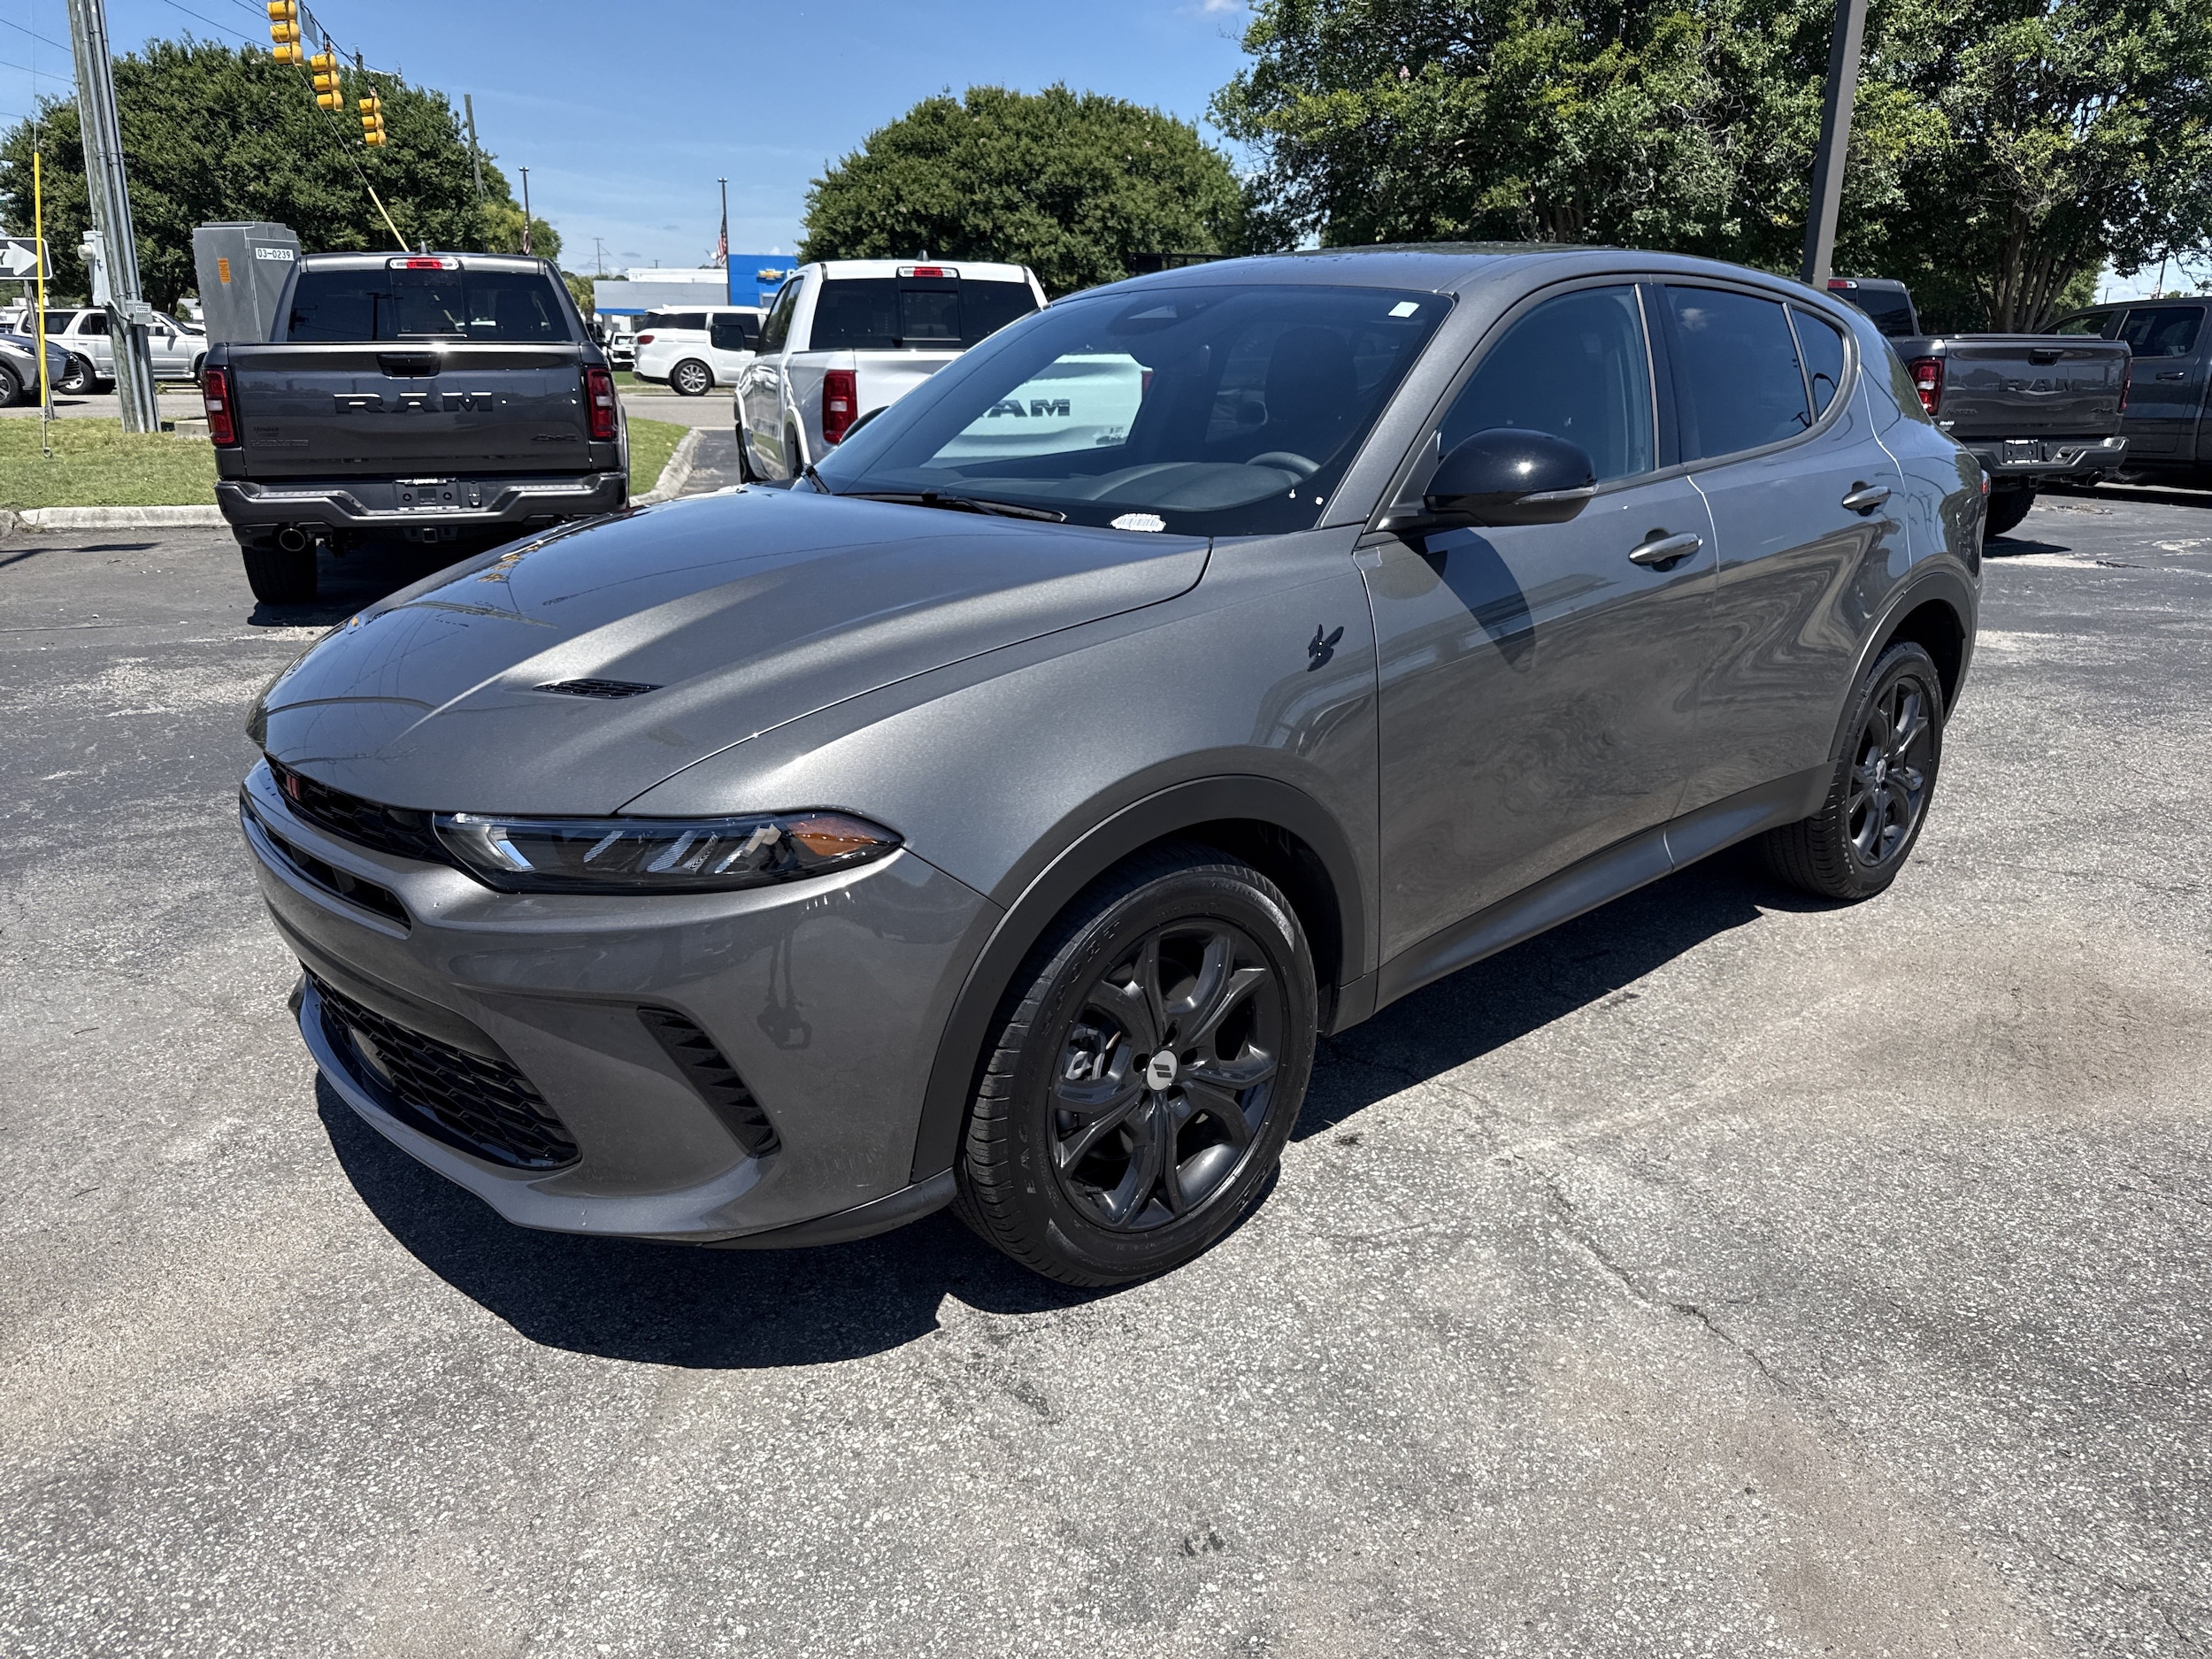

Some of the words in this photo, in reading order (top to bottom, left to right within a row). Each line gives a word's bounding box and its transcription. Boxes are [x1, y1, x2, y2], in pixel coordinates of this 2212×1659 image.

[257, 249, 291, 259] 03-0239
[1999, 378, 2082, 393] RAM
[333, 391, 493, 413] RAM
[982, 398, 1071, 418] AM
